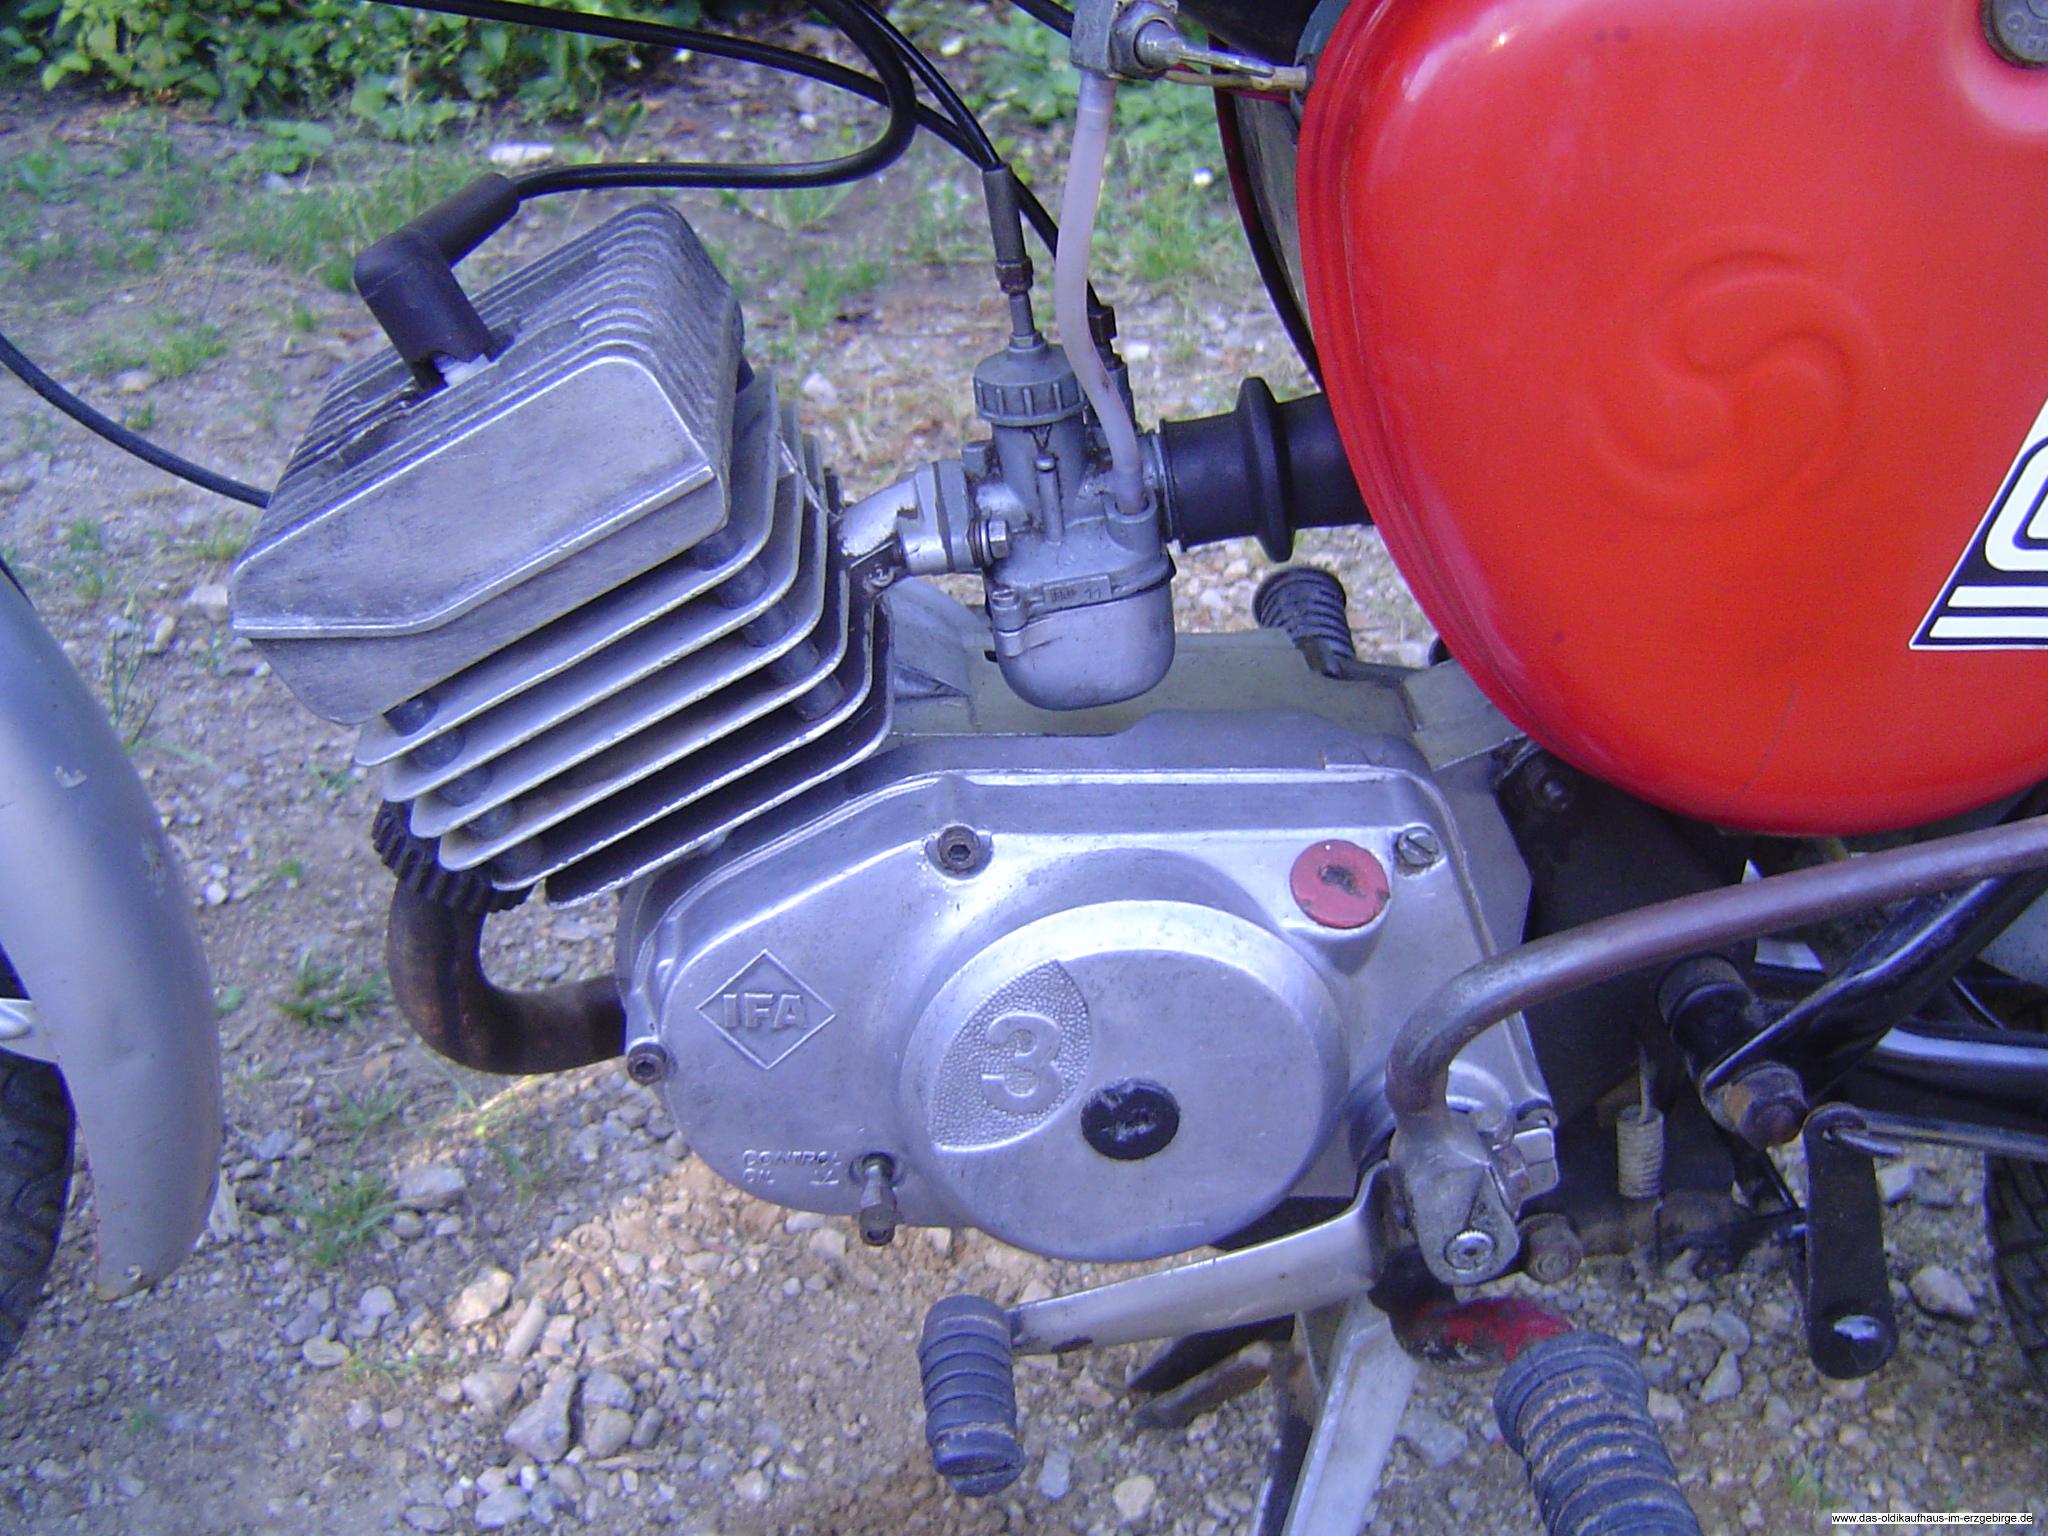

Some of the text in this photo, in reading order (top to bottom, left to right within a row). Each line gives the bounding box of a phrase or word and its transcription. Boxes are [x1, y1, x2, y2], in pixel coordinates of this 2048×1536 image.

[721, 992, 809, 1030] IFA
[981, 1012, 1063, 1116] 3
[742, 1149, 842, 1167] CONTROL
